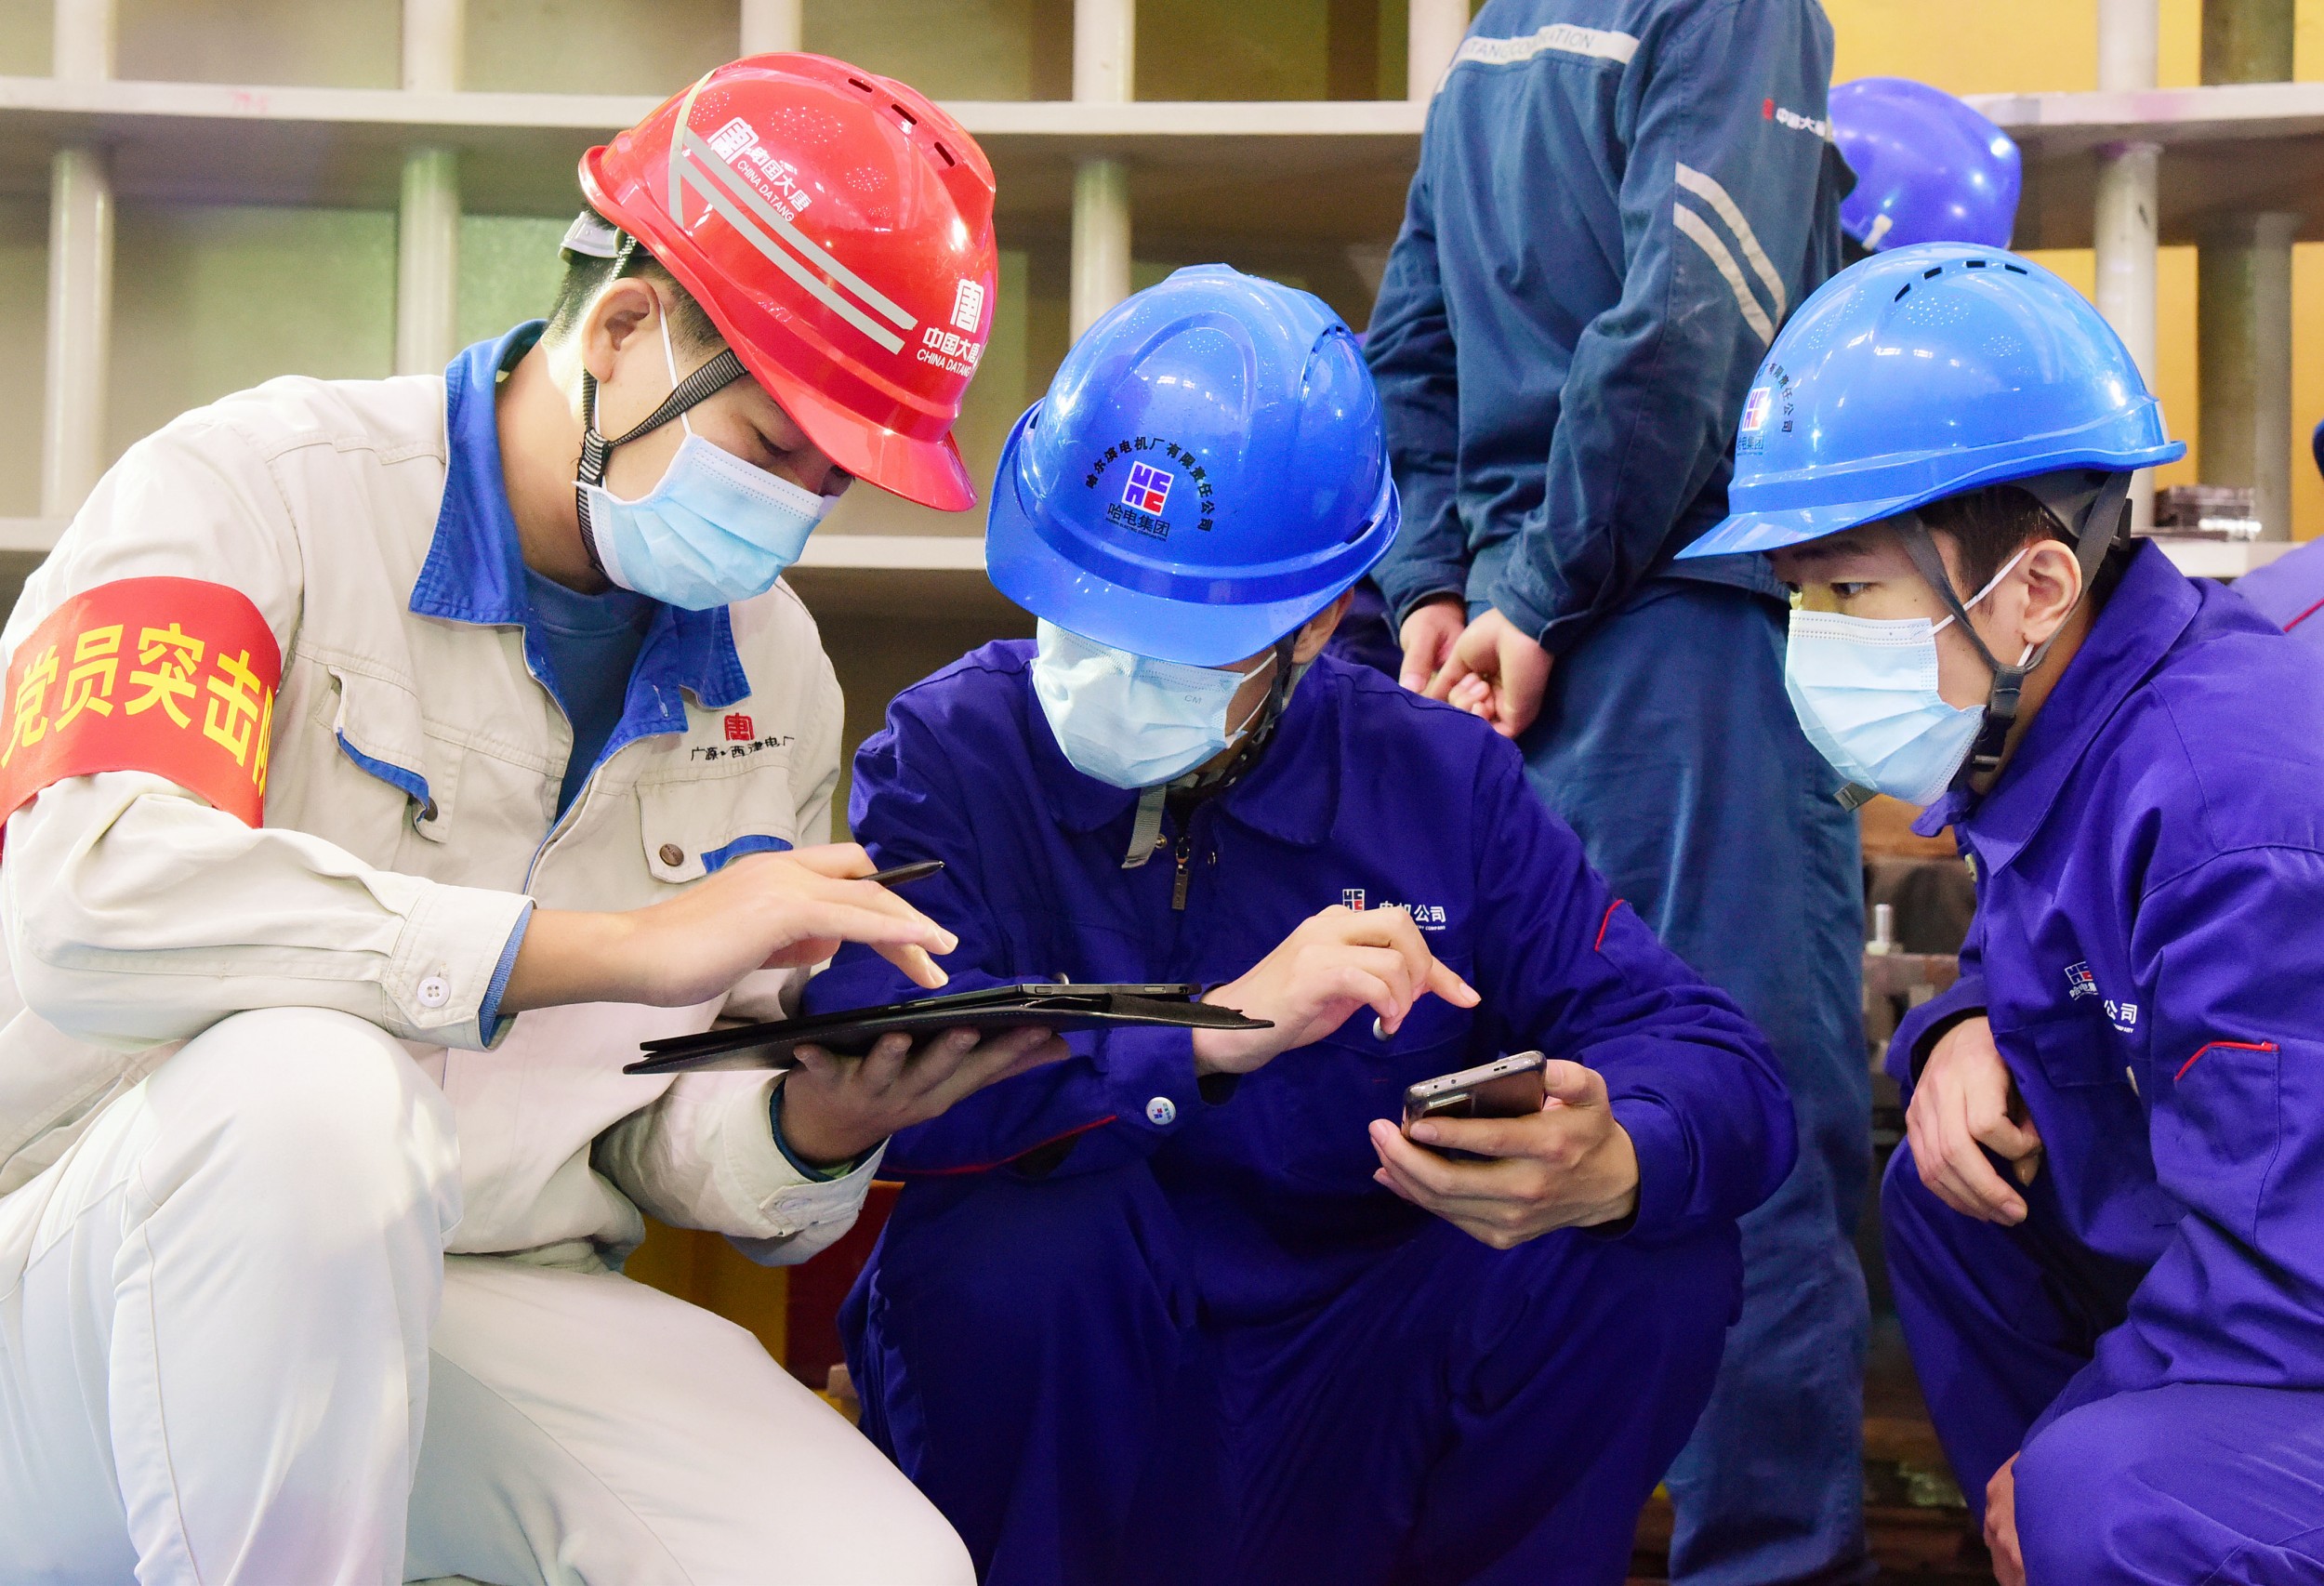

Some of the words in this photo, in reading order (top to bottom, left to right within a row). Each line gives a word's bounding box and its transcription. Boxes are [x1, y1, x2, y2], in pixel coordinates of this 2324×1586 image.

[737, 160, 761, 188] CHINA
[759, 184, 795, 222] DATANG
[917, 349, 946, 368] CHINA
[1085, 436, 1216, 532] 哈尔滨电机厂有限责任公司
[1107, 503, 1171, 537] 哈电集团
[2104, 999, 2138, 1024] 公司
